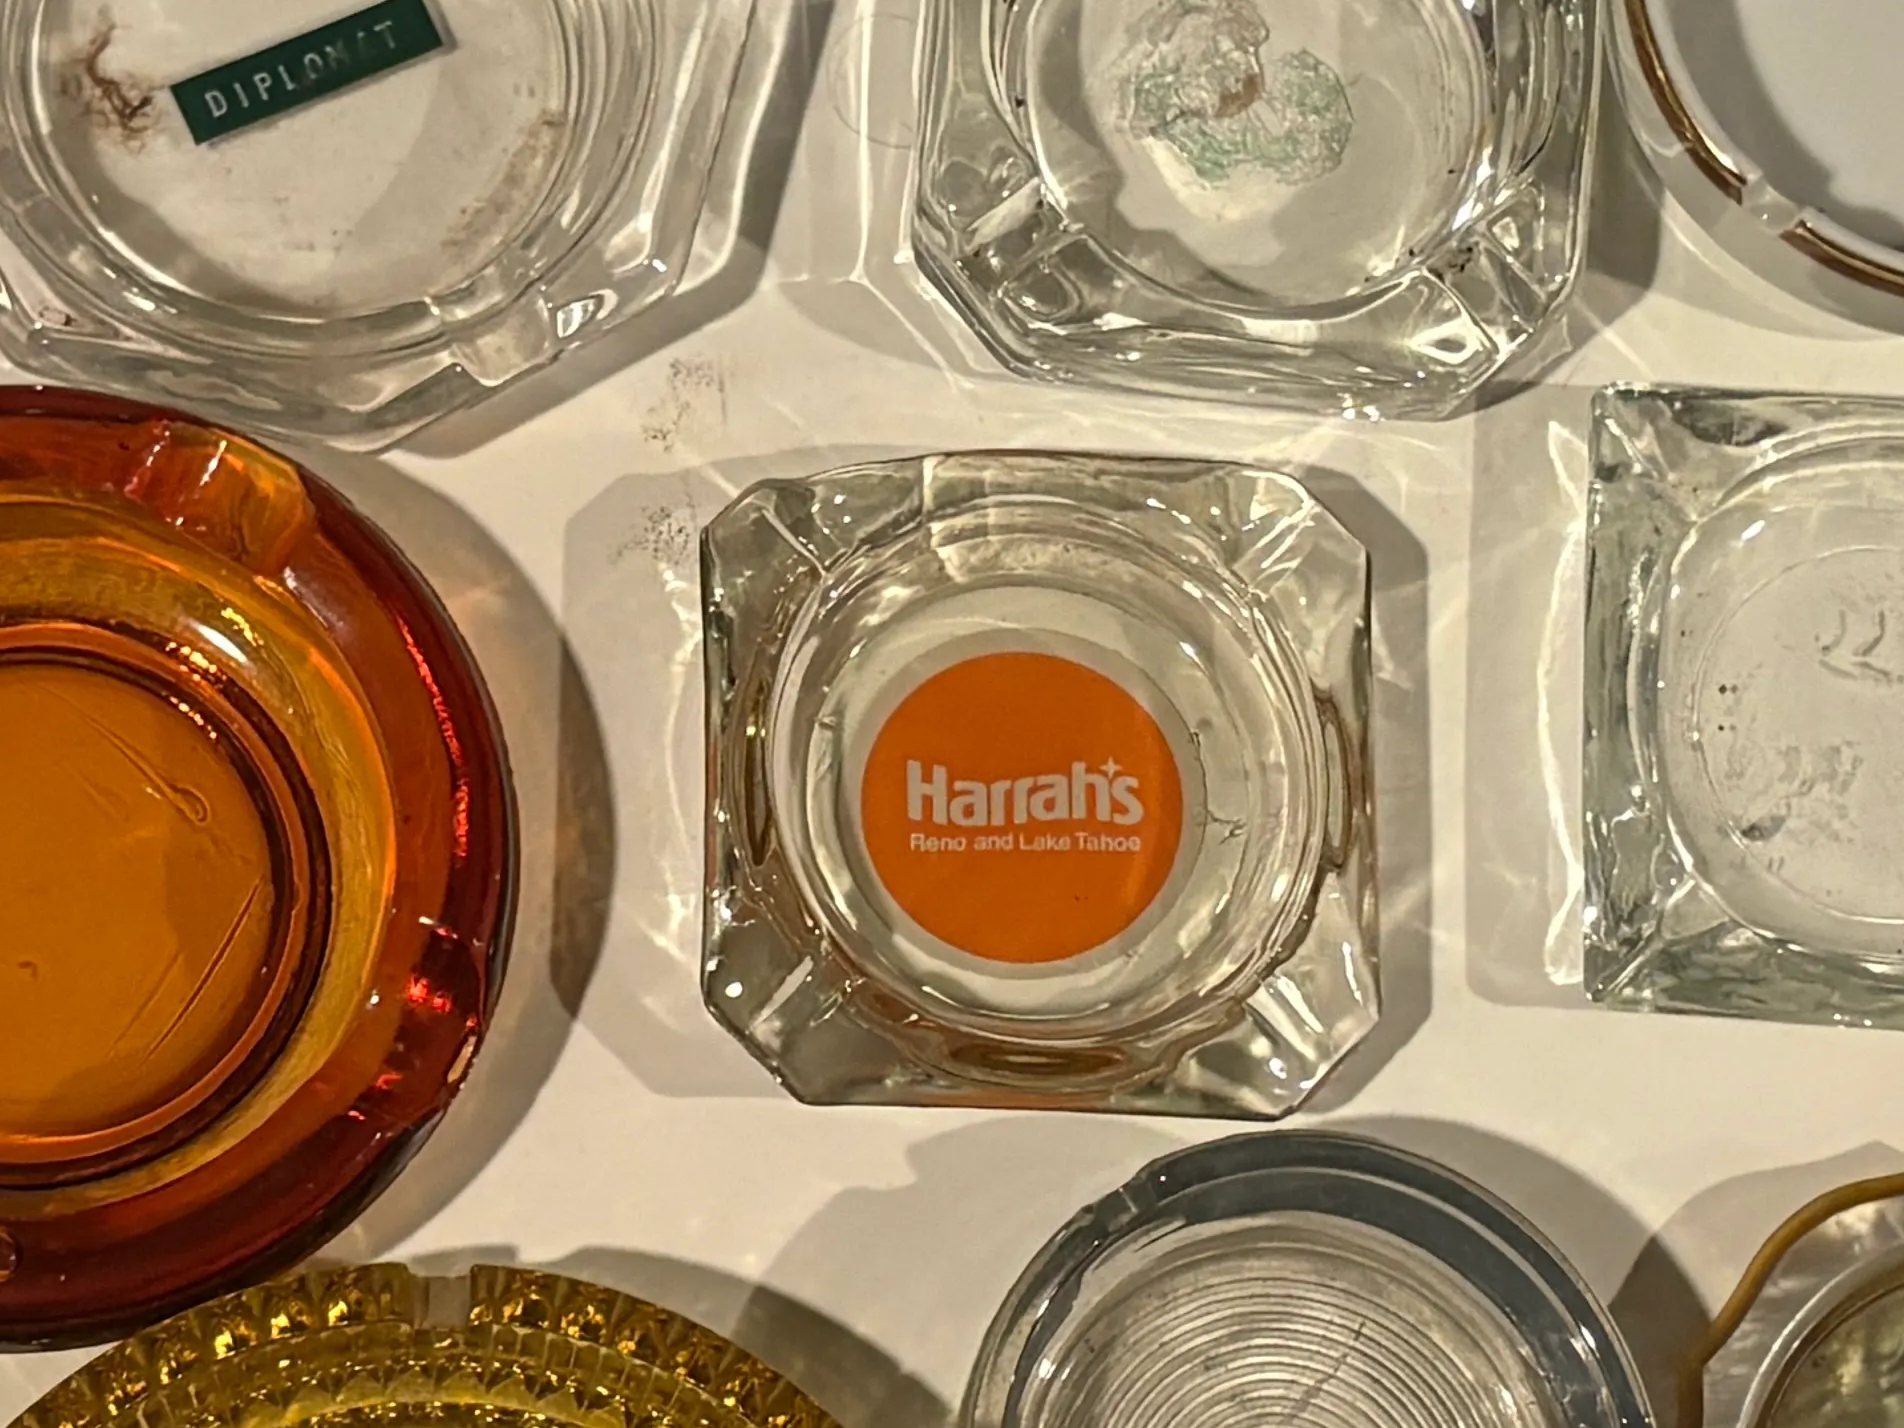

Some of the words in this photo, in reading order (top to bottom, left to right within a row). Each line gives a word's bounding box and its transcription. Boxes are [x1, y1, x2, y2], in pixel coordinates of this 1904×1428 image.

[906, 757, 1145, 827] Harrah's
[910, 832, 967, 852] Reno
[973, 832, 1014, 852] and
[1019, 832, 1071, 852] Lake
[1075, 832, 1142, 853] Tahoe
